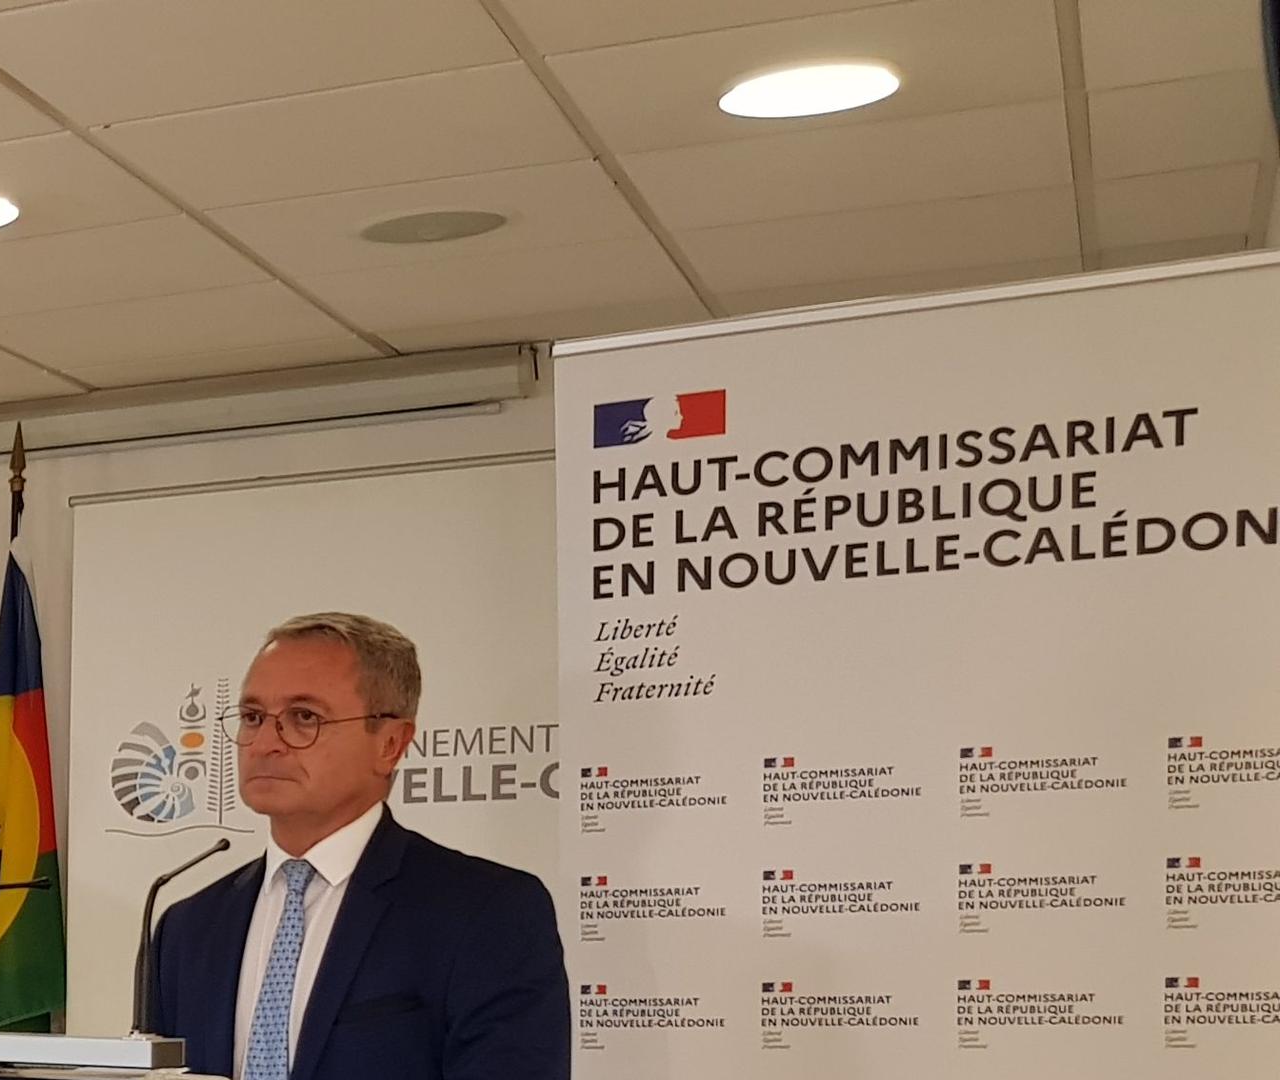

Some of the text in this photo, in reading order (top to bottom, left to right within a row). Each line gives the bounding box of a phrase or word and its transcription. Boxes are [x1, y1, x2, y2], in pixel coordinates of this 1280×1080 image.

[593, 407, 1198, 504] HAUT-COMMISSARIAT
[593, 471, 1096, 552] DE LA RÉPUBLIQUE
[593, 560, 655, 600] EN
[594, 615, 679, 641] Liberté
[593, 646, 680, 677] Égalité
[593, 674, 716, 703] Fraternité
[959, 757, 1098, 771] HAUT-COMMISSARIAT
[959, 769, 1076, 782] DE LA RÉPUBLIQUE
[578, 776, 701, 789] HAUT-COMMISSARIAT
[959, 778, 1126, 793] EN NOUVELLE-CALÉDONIE
[578, 787, 681, 799] DE LA RÉPUBLIQUE
[578, 796, 726, 810] EN NOUVELLE-CALÉDONIE
[762, 881, 892, 893] HAUT-COMMISSARIAT
[762, 893, 872, 903] DE LA RÉPUBLIQUE
[762, 902, 919, 914] EN NOUVELLE-CALÉDONIE
[577, 998, 699, 1006] HAUT-COMMISSARIAT
[957, 993, 1095, 1002] HAUT-COMMISSARIAT
[612, 1008, 680, 1017] RÉPUBLIQUE
[957, 1004, 1073, 1014] DE LA RÉPUBLIQUE
[1164, 1004, 1180, 1012] DE
[1185, 1003, 1201, 1012] LA
[577, 1017, 724, 1027] EN NOUVELLE-CALÉDONIE
[957, 1014, 1124, 1025] EN NOUVELLE-CALÉDONIE
[1164, 1015, 1181, 1024] EN
